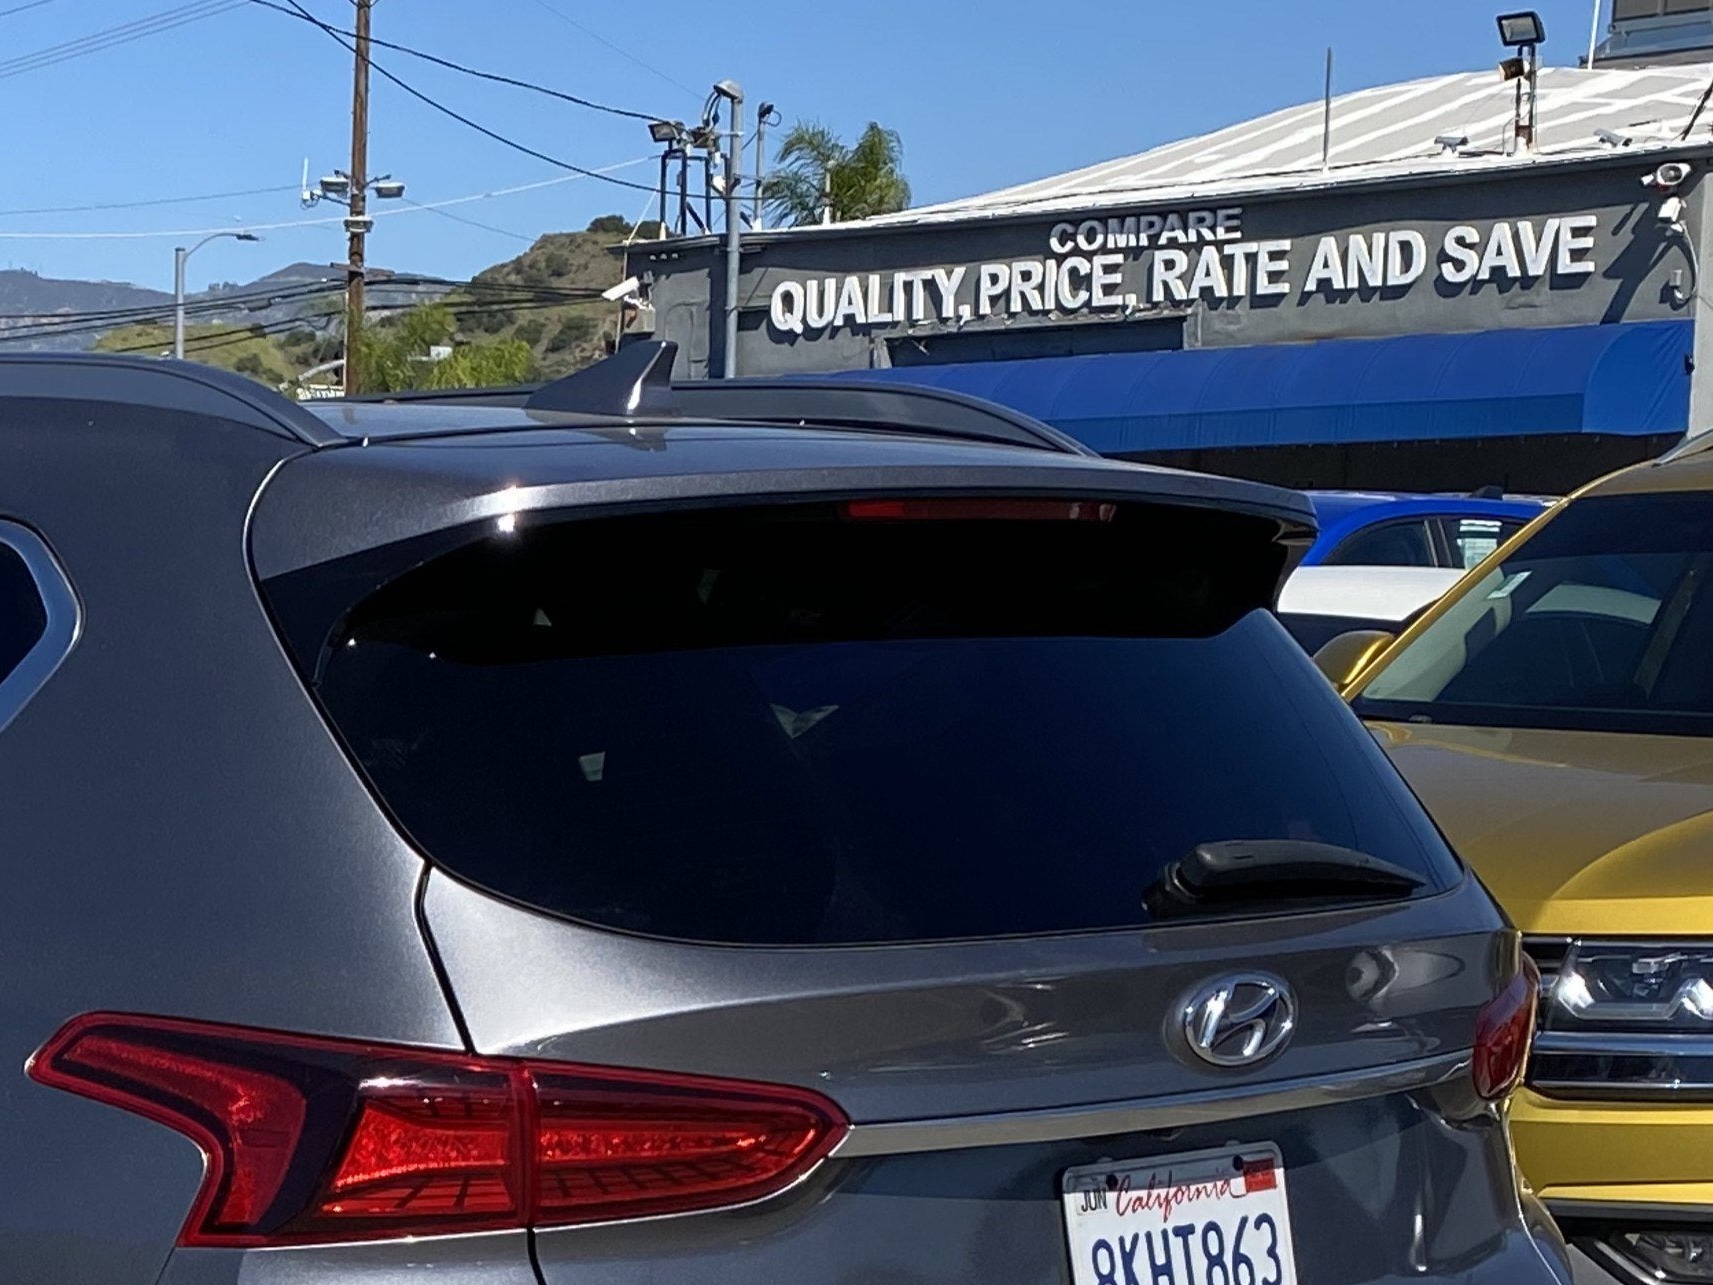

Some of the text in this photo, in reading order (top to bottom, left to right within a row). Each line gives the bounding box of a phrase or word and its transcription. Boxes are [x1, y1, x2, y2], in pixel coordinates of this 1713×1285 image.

[1050, 207, 1243, 254] COMPARE
[770, 215, 1597, 334] QUALITY, PRICE, RATE AND SAVE
[1081, 1184, 1108, 1213] JUN
[1115, 1169, 1234, 1223] California
